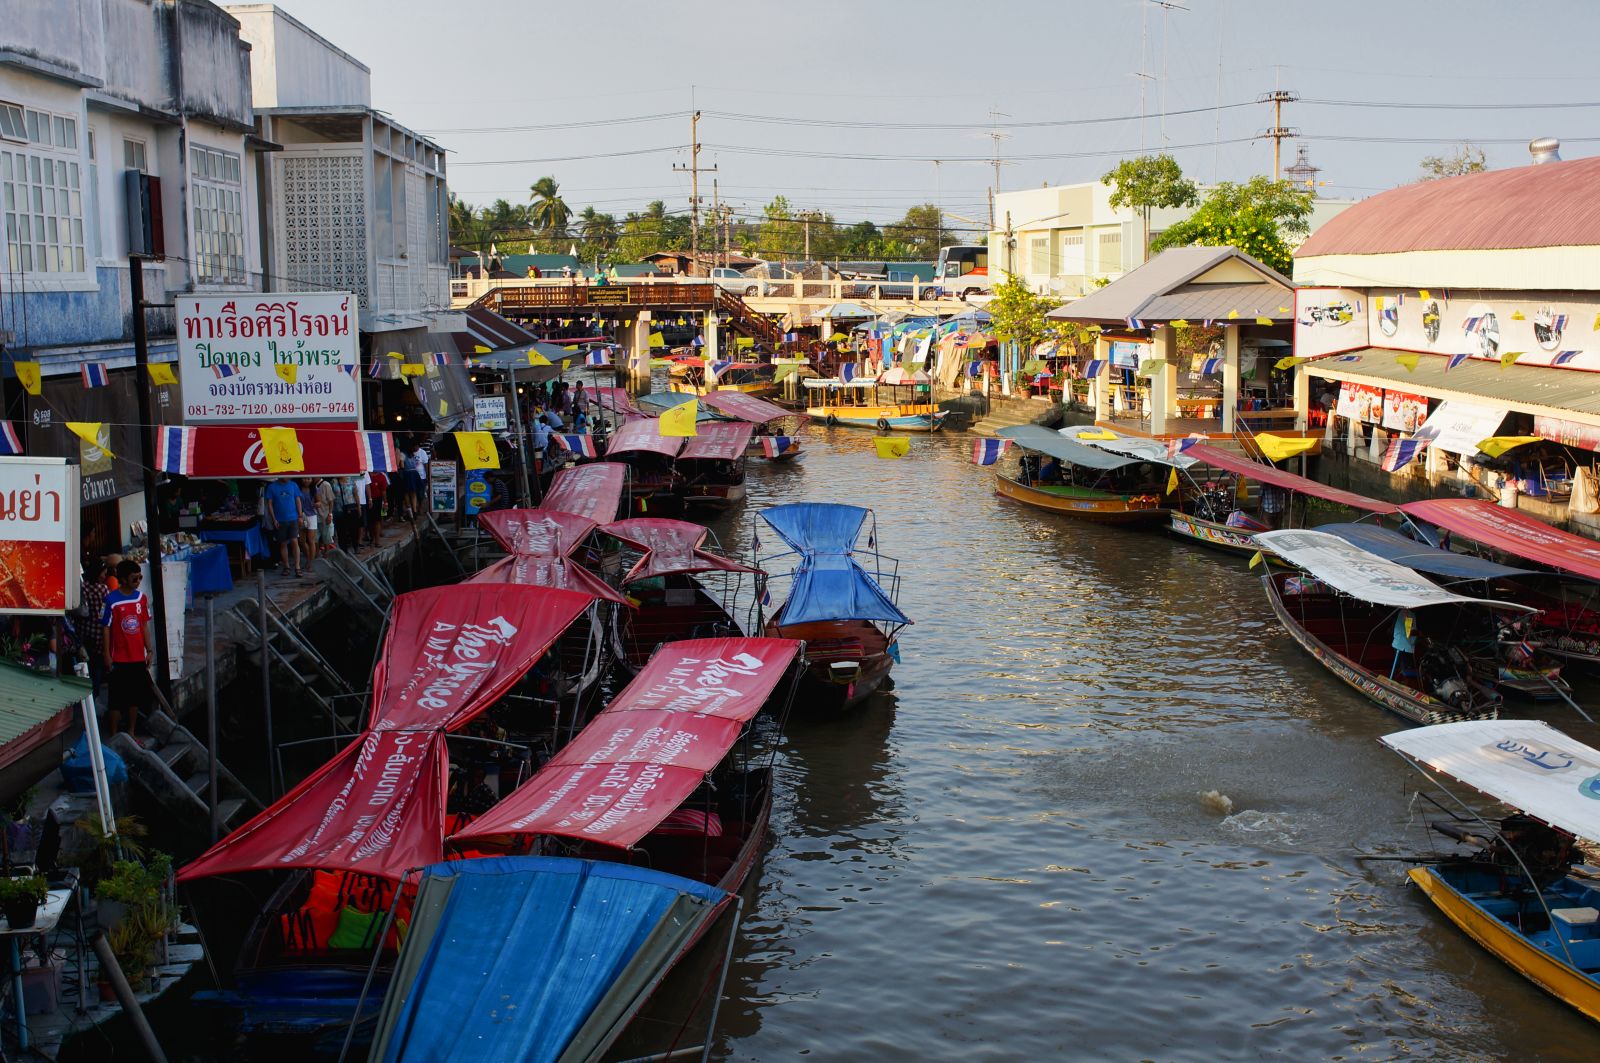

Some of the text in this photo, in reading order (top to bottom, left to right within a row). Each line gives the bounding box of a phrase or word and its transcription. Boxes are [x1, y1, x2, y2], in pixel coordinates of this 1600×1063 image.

[183, 296, 349, 339] ท่าเรือศิริโรจน์
[195, 340, 341, 368] ปิดทอง ไหว้พระ
[82, 477, 117, 501] อัมพวา
[136, 602, 142, 614] 8
